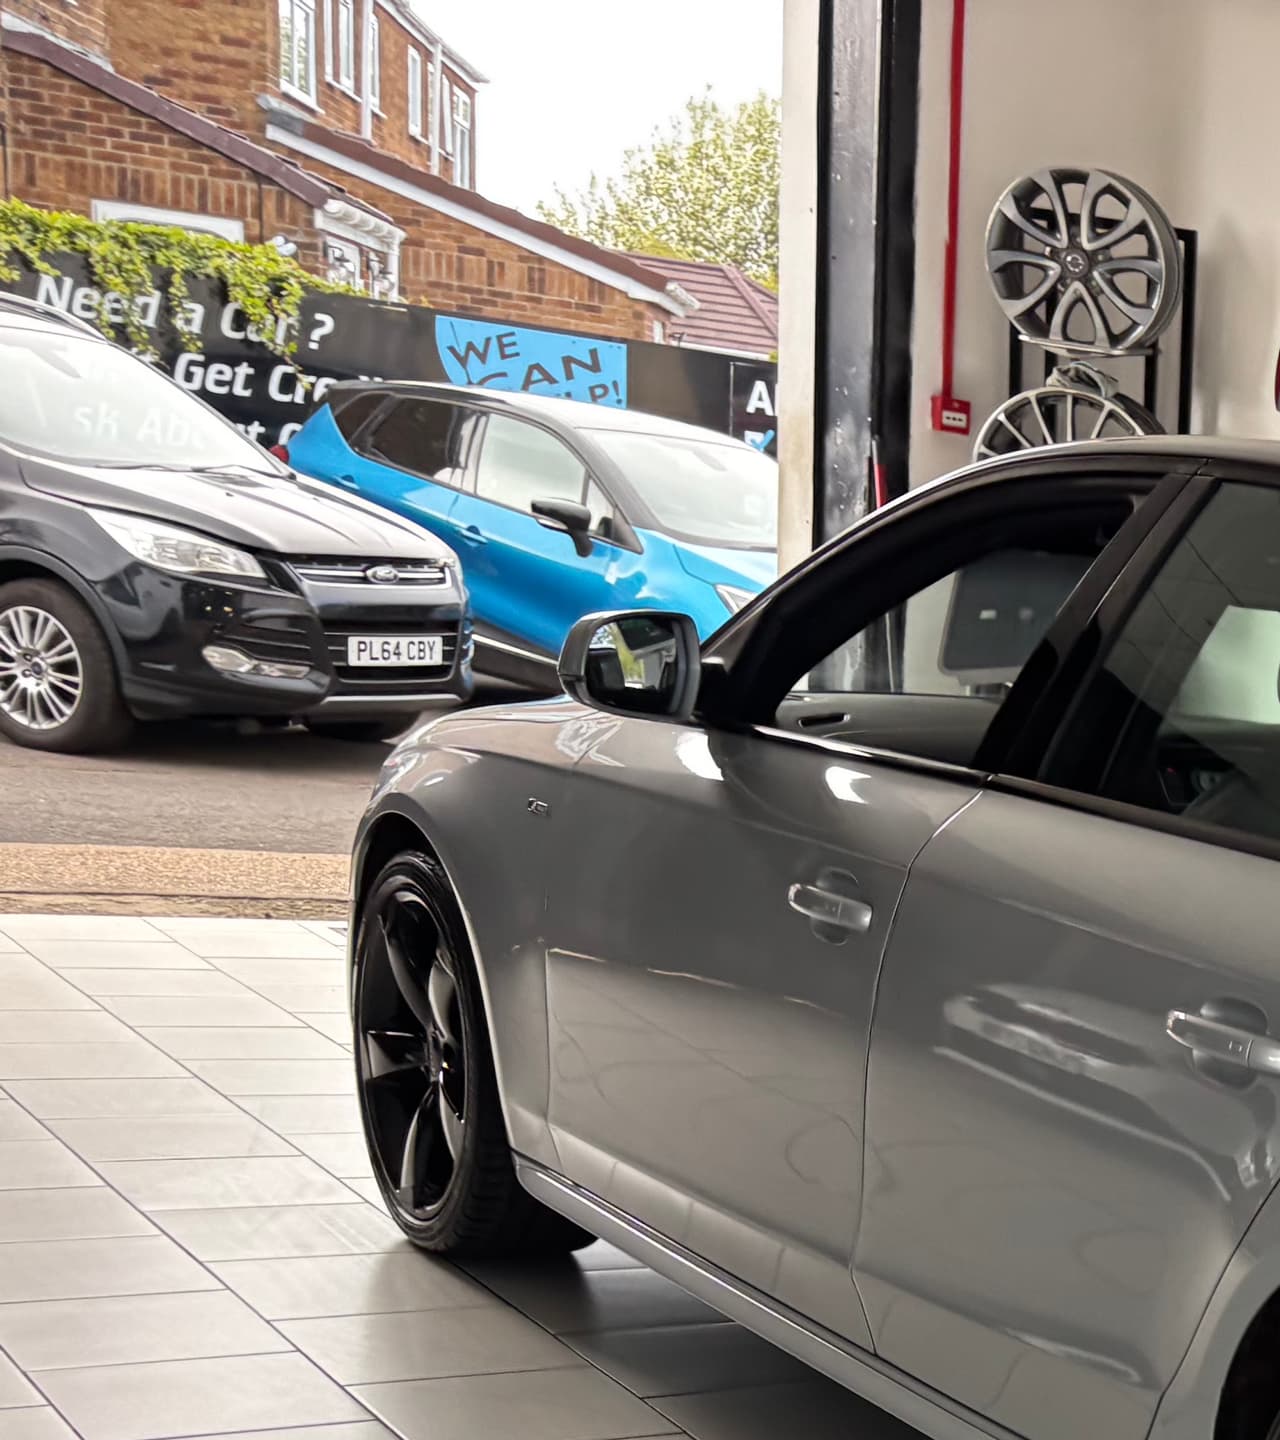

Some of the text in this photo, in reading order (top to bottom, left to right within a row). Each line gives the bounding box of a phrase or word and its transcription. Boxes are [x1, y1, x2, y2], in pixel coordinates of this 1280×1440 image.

[37, 272, 162, 329] Need
[174, 298, 206, 335] a
[446, 330, 521, 369] WE
[172, 353, 256, 399] Get
[356, 640, 436, 662] PL64 CBY
